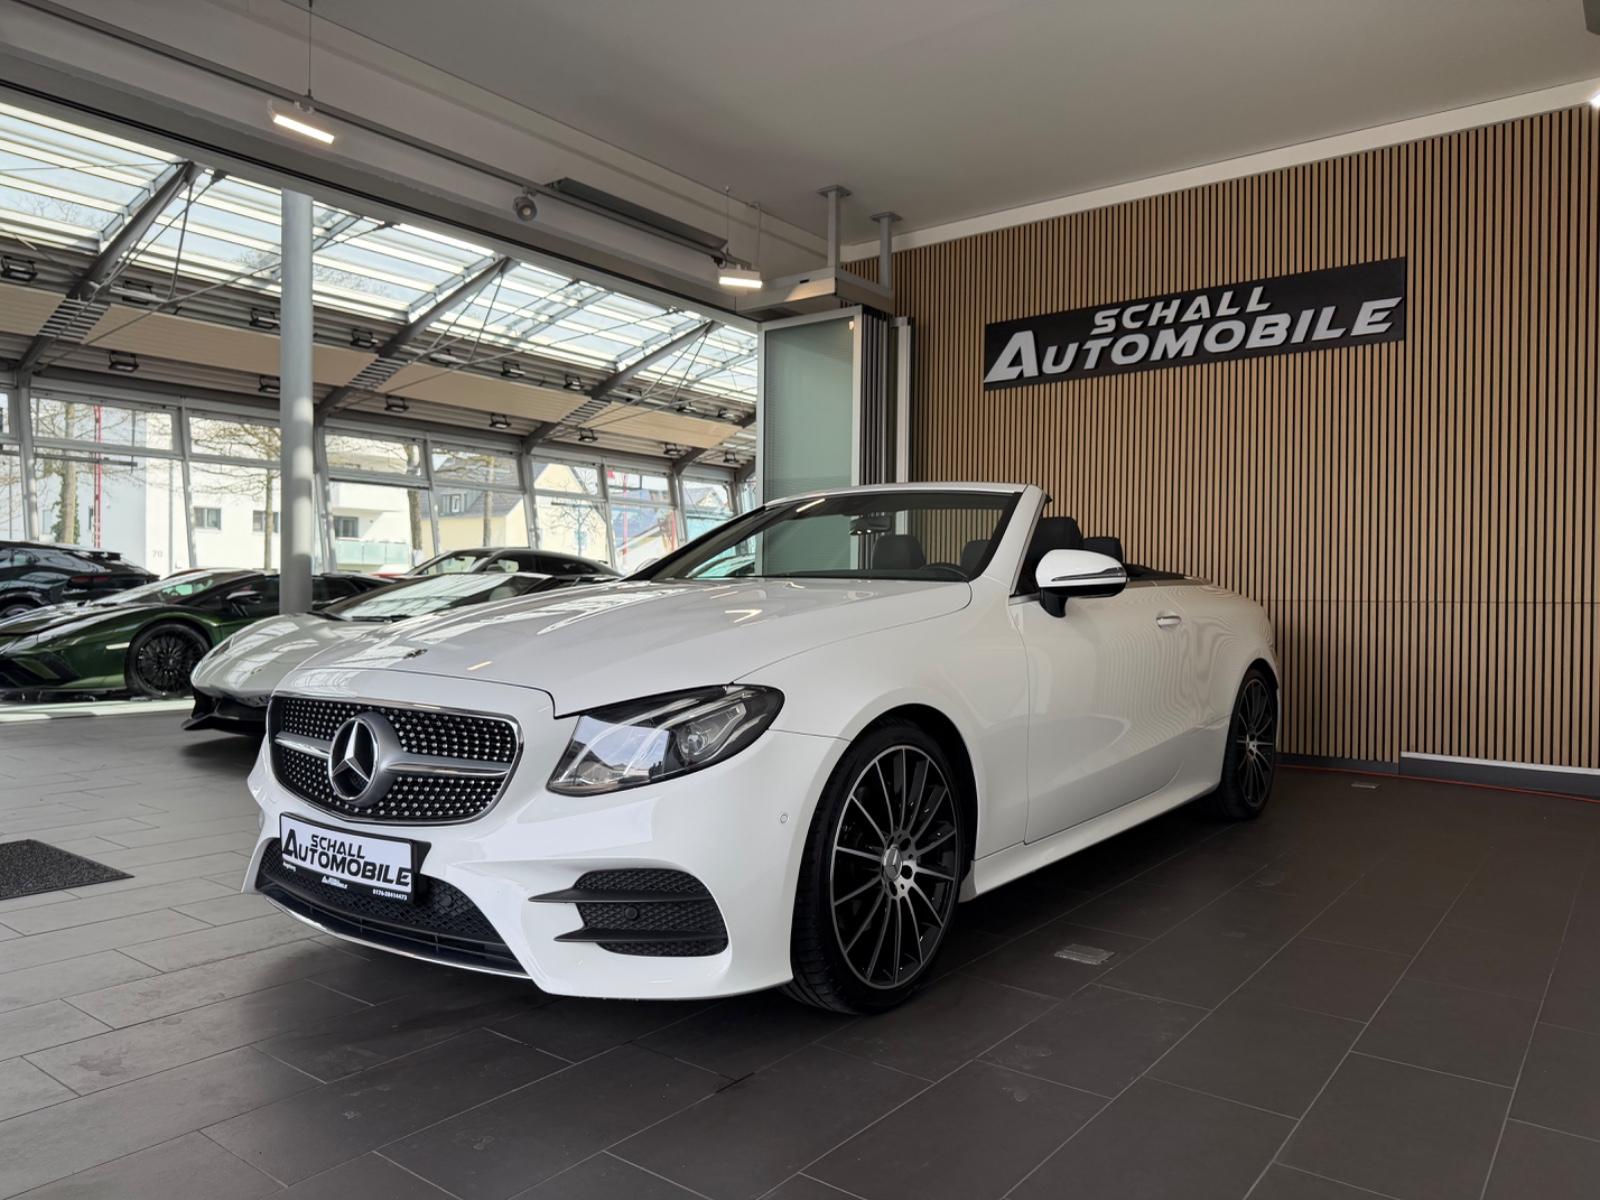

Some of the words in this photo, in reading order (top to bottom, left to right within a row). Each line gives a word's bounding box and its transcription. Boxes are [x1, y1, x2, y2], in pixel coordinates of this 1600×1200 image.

[1091, 286, 1272, 335] SCHALL
[984, 297, 1402, 383] AUTOMOBILE
[282, 828, 411, 887] AUTOMOBILE
[311, 834, 365, 859] SCHALL
